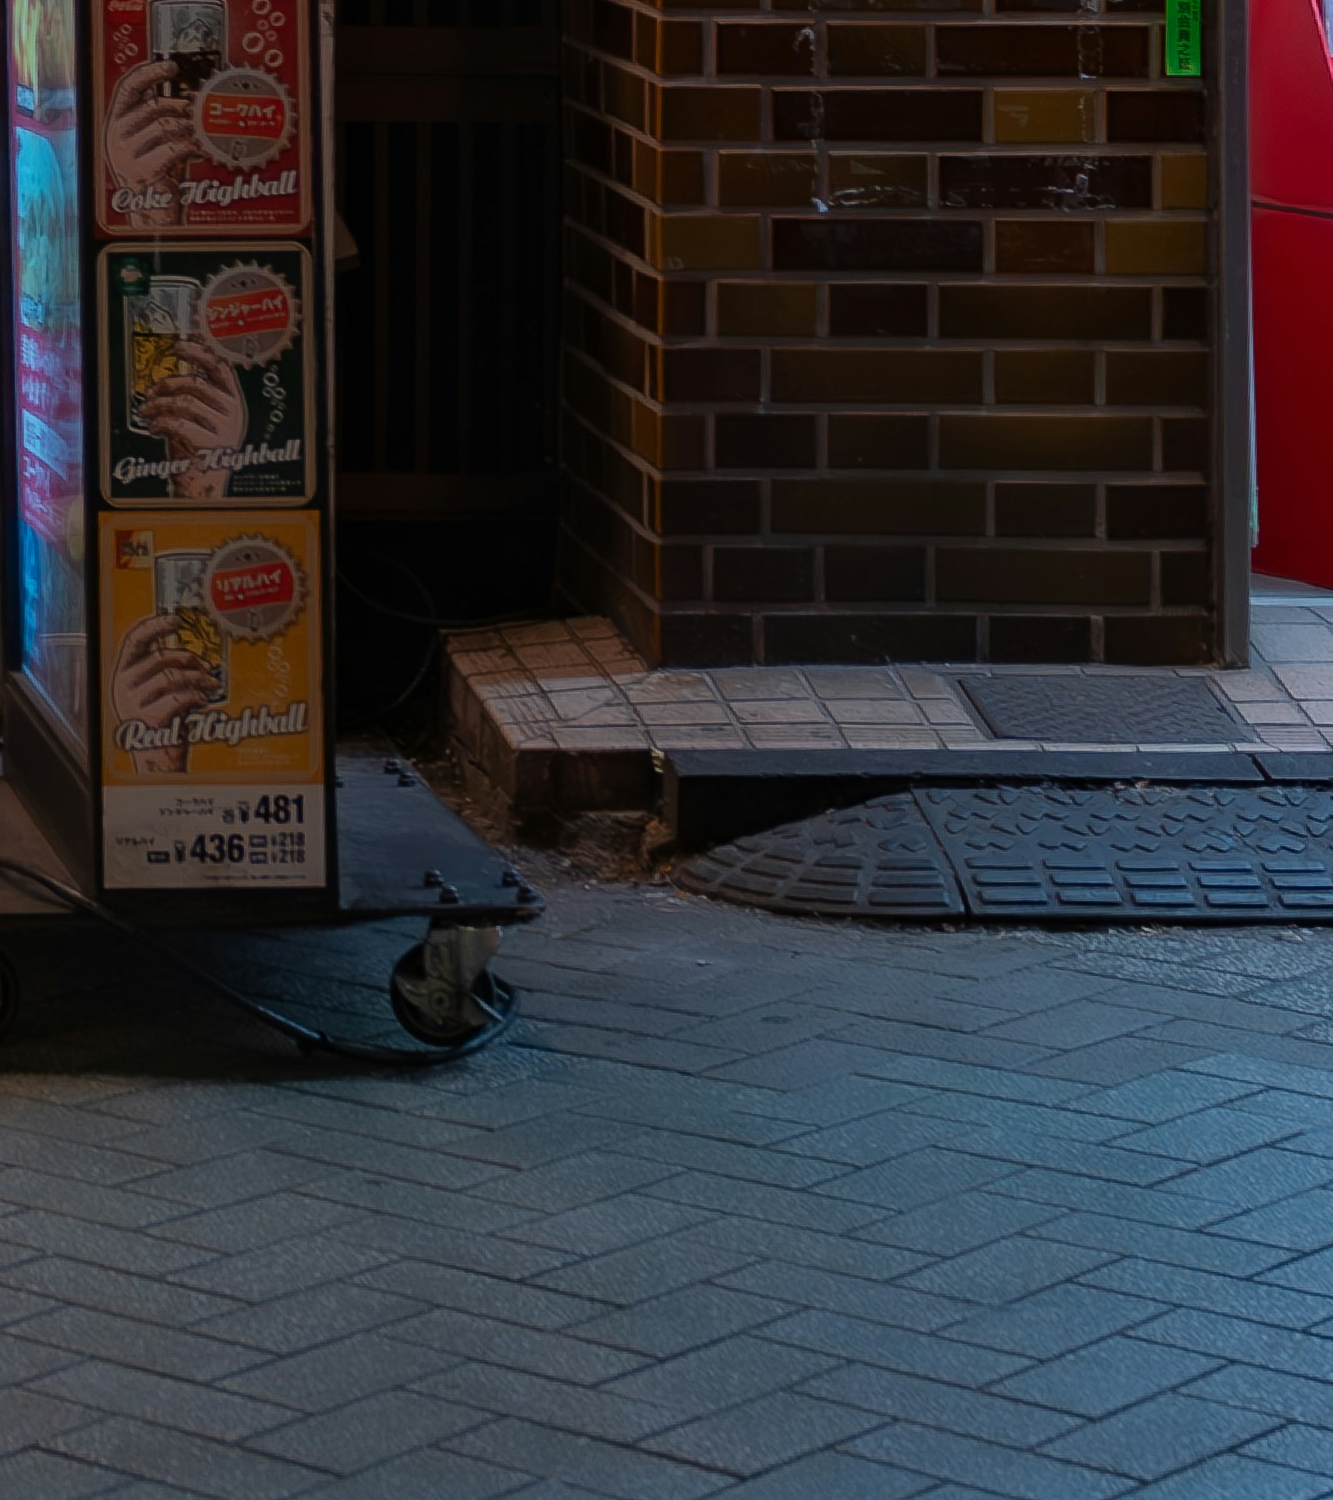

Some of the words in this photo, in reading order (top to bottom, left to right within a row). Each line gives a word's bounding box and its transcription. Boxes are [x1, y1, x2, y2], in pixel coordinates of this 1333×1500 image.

[112, 185, 173, 213] Coke
[180, 170, 299, 208] Highball
[112, 454, 192, 487] Ginger
[193, 438, 303, 477] Highball
[116, 720, 184, 753] Real
[185, 703, 309, 746] Highball
